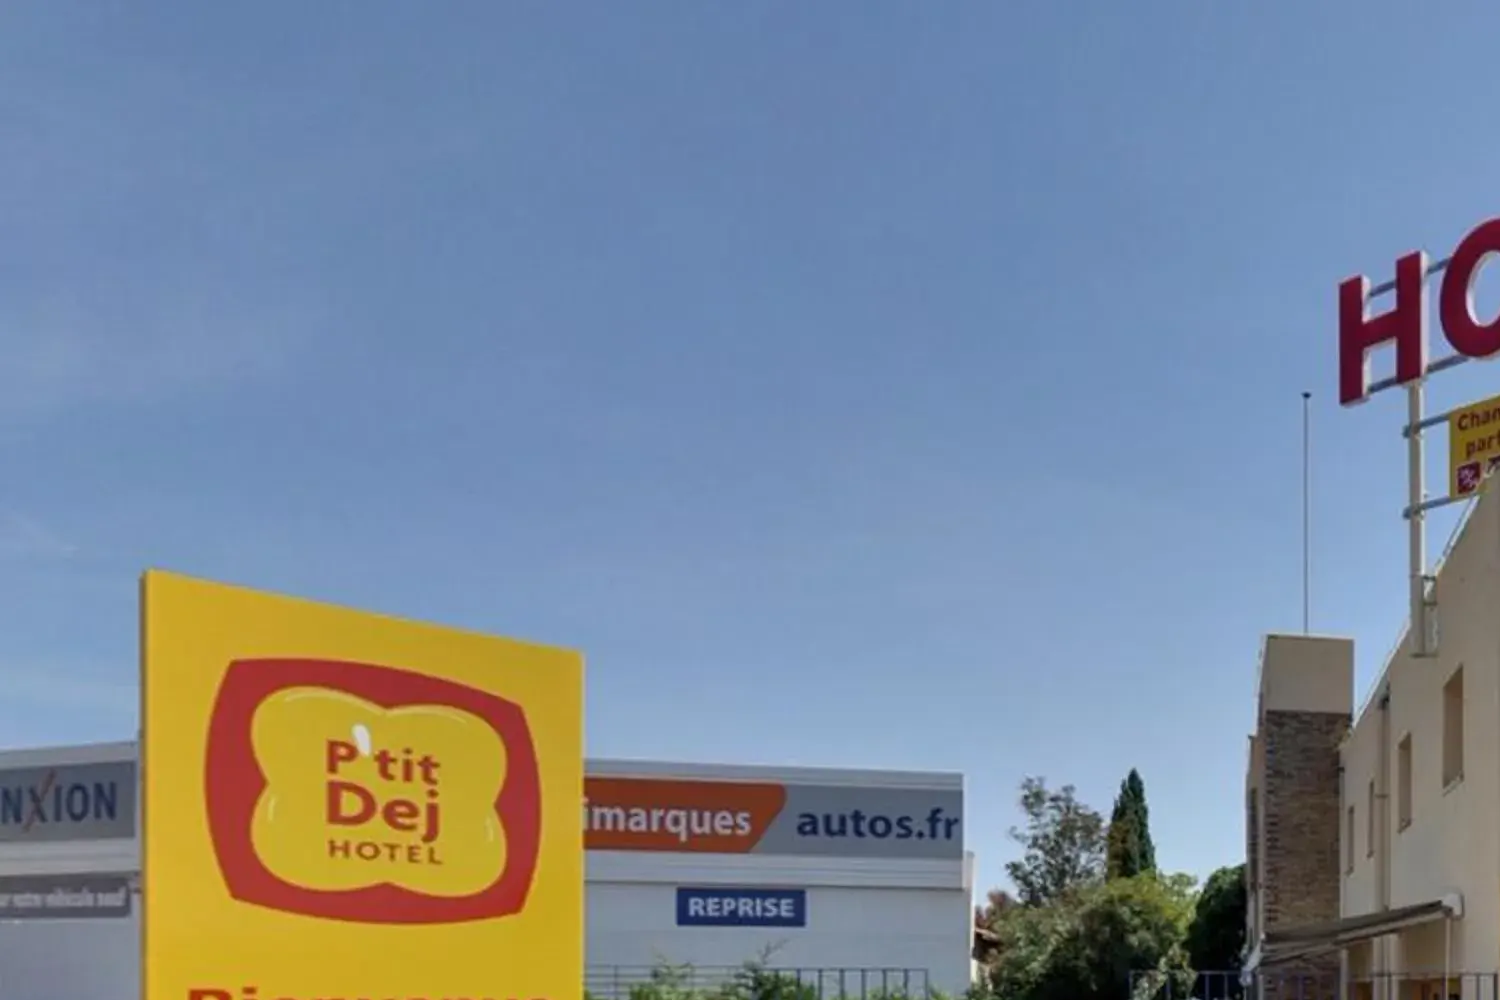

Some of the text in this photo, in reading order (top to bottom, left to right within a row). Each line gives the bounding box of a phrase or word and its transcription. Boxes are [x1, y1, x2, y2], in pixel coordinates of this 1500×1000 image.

[327, 780, 440, 844] Dej
[796, 807, 960, 841] autos.fr
[327, 839, 444, 866] HOTEL
[688, 896, 796, 919] REPRISE
